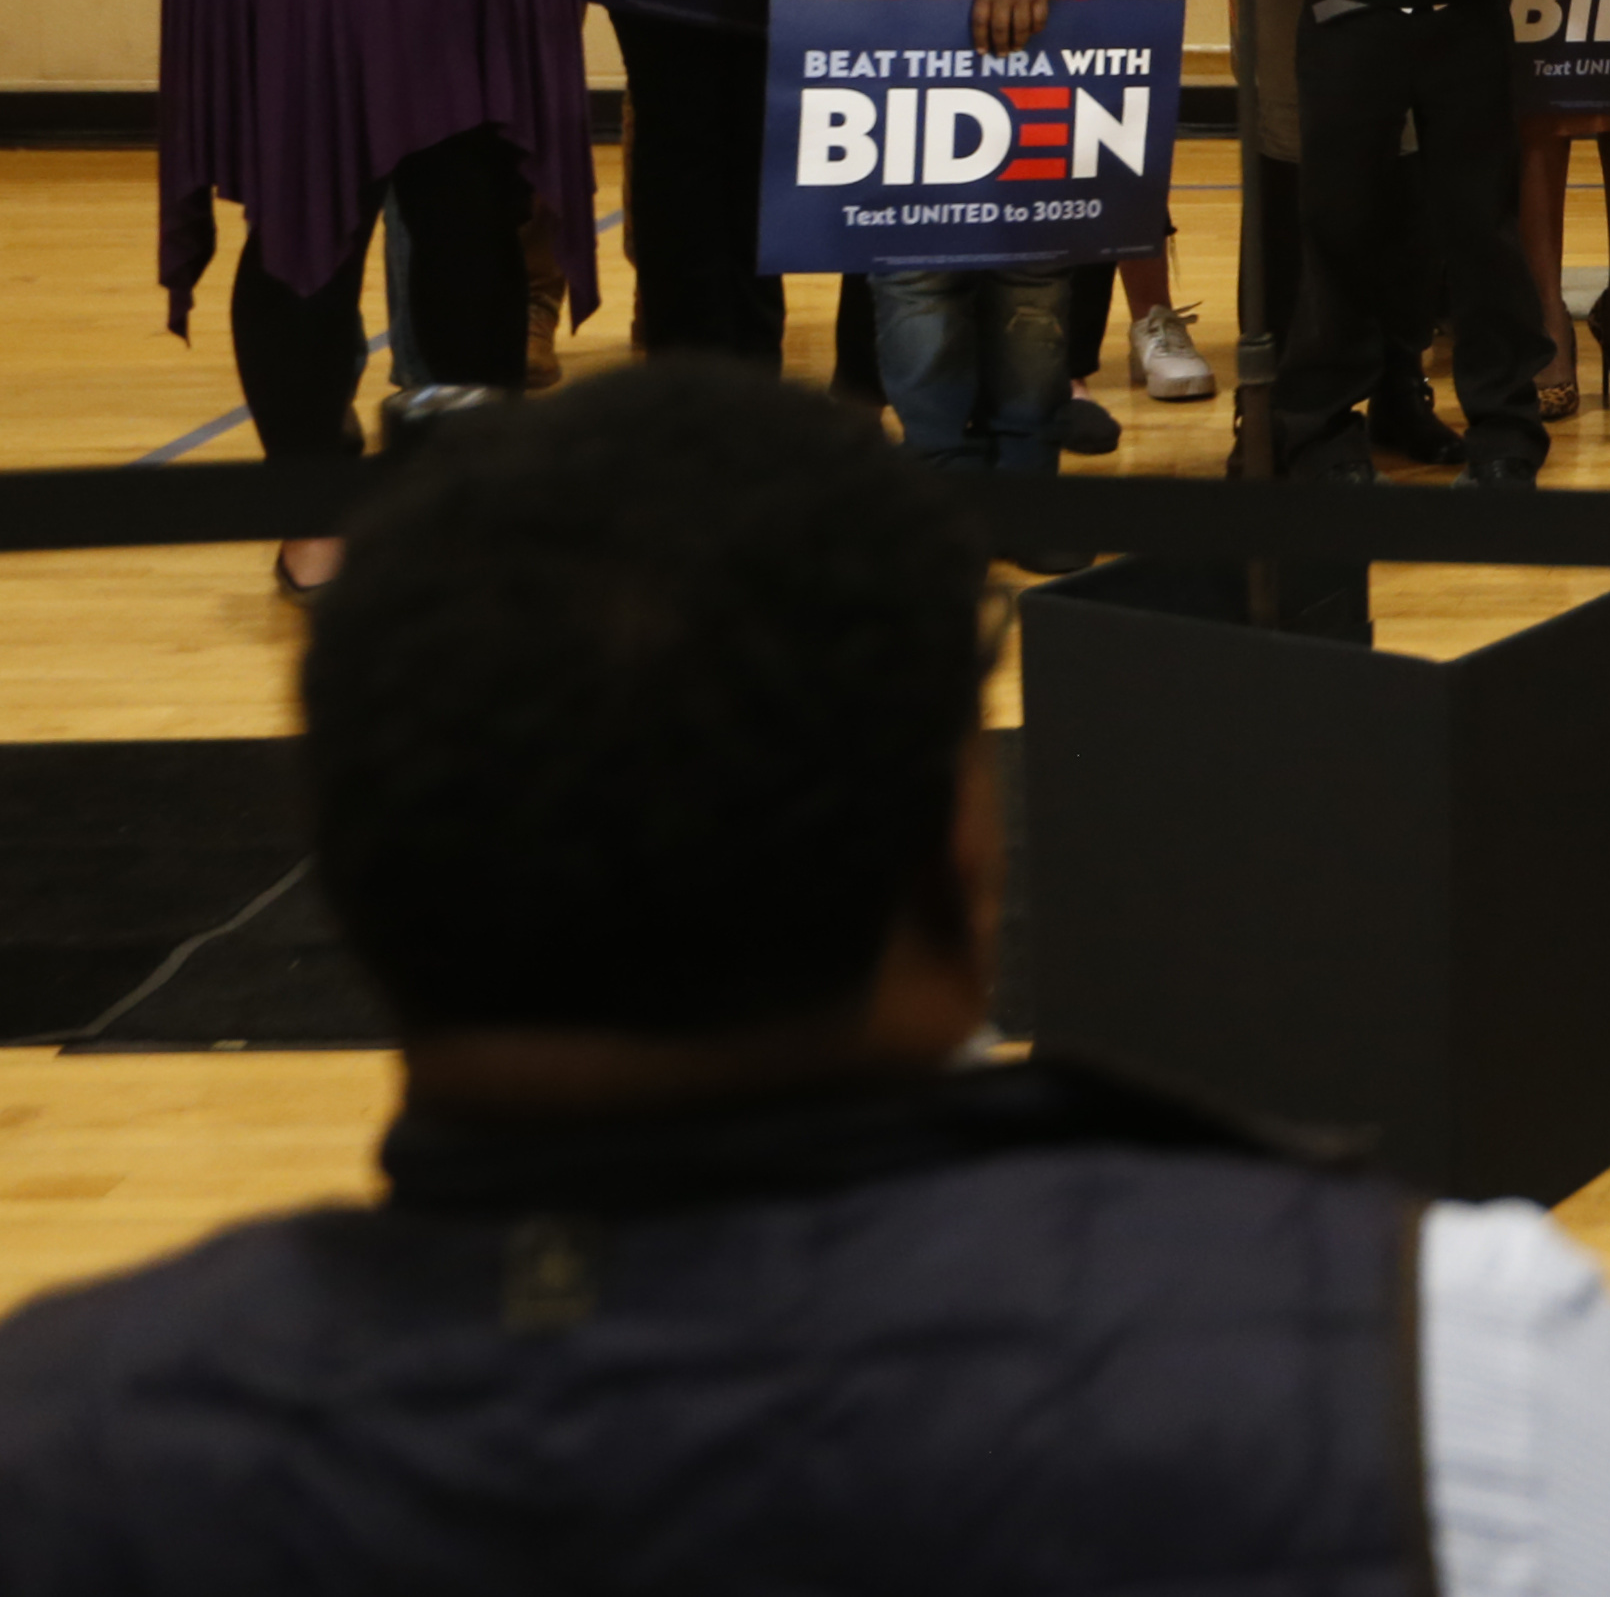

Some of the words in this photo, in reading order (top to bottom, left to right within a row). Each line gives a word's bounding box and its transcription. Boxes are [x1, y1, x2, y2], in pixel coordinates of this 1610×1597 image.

[803, 50, 897, 79] BEAT
[902, 50, 974, 78] THE
[1061, 48, 1151, 76] WITH
[1534, 60, 1571, 77] Text
[796, 86, 1151, 187] BIDEN
[842, 205, 897, 227] Text
[902, 202, 999, 226] UNITED
[1004, 204, 1028, 222] to
[1033, 199, 1103, 222] 30330
